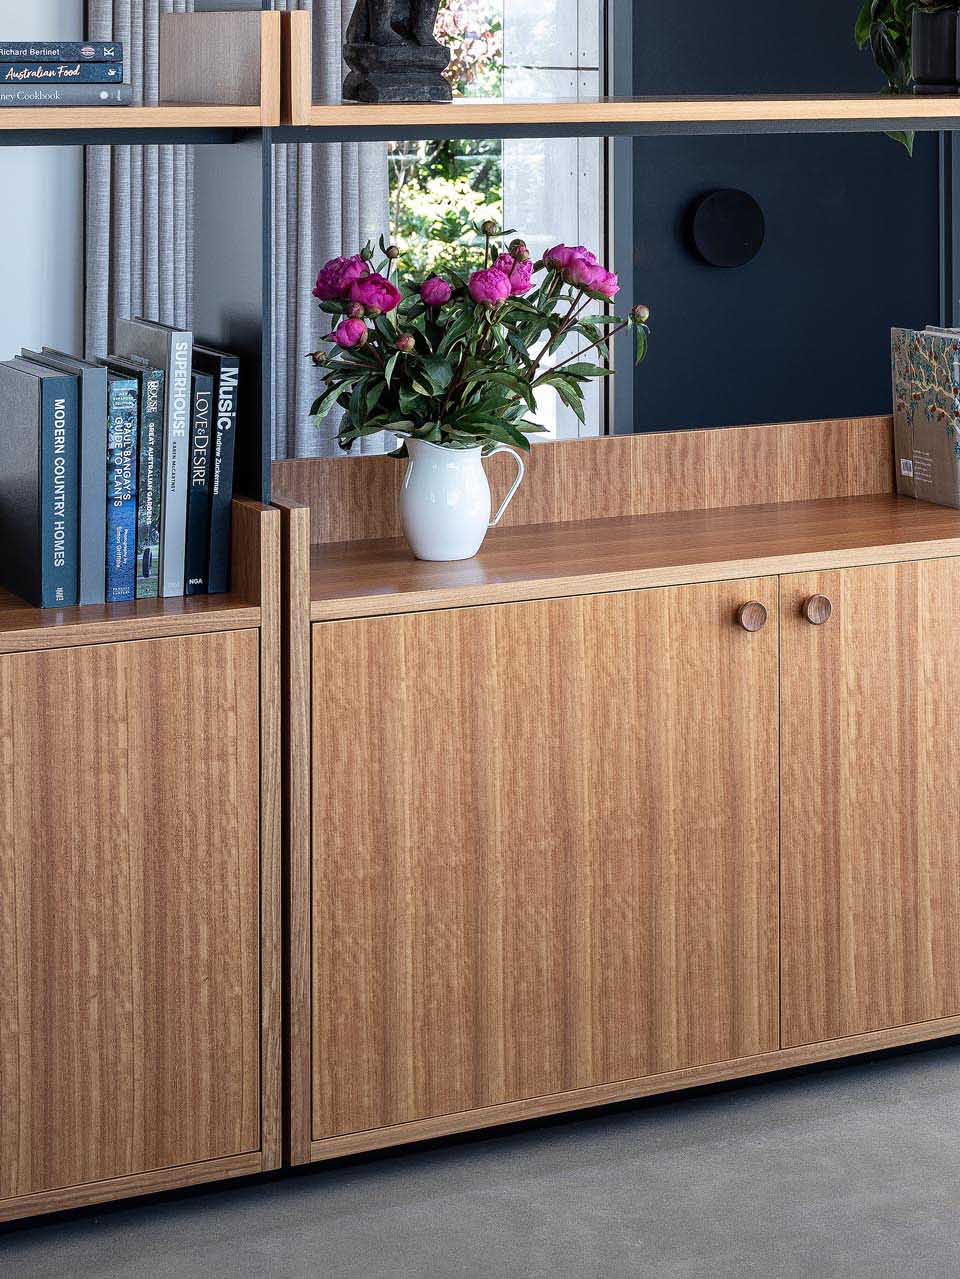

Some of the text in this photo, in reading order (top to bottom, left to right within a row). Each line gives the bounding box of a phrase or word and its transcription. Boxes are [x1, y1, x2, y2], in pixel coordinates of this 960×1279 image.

[0, 48, 60, 56] Richard Bertinet
[5, 64, 80, 80] Australian Food
[17, 90, 61, 100] Cookbook
[173, 342, 188, 438] SUPERHOUSE
[217, 367, 239, 431] Music
[194, 391, 211, 429] LOVE
[114, 416, 123, 449] GUIDE
[114, 451, 123, 465] TO
[122, 422, 132, 500] PAUL BANGAY'S
[192, 435, 208, 487] DESIRE
[213, 431, 223, 495] Andrew Zuckerman
[53, 398, 65, 568] MODERN COUNTRY HOMES
[113, 468, 122, 507] PLANTS
